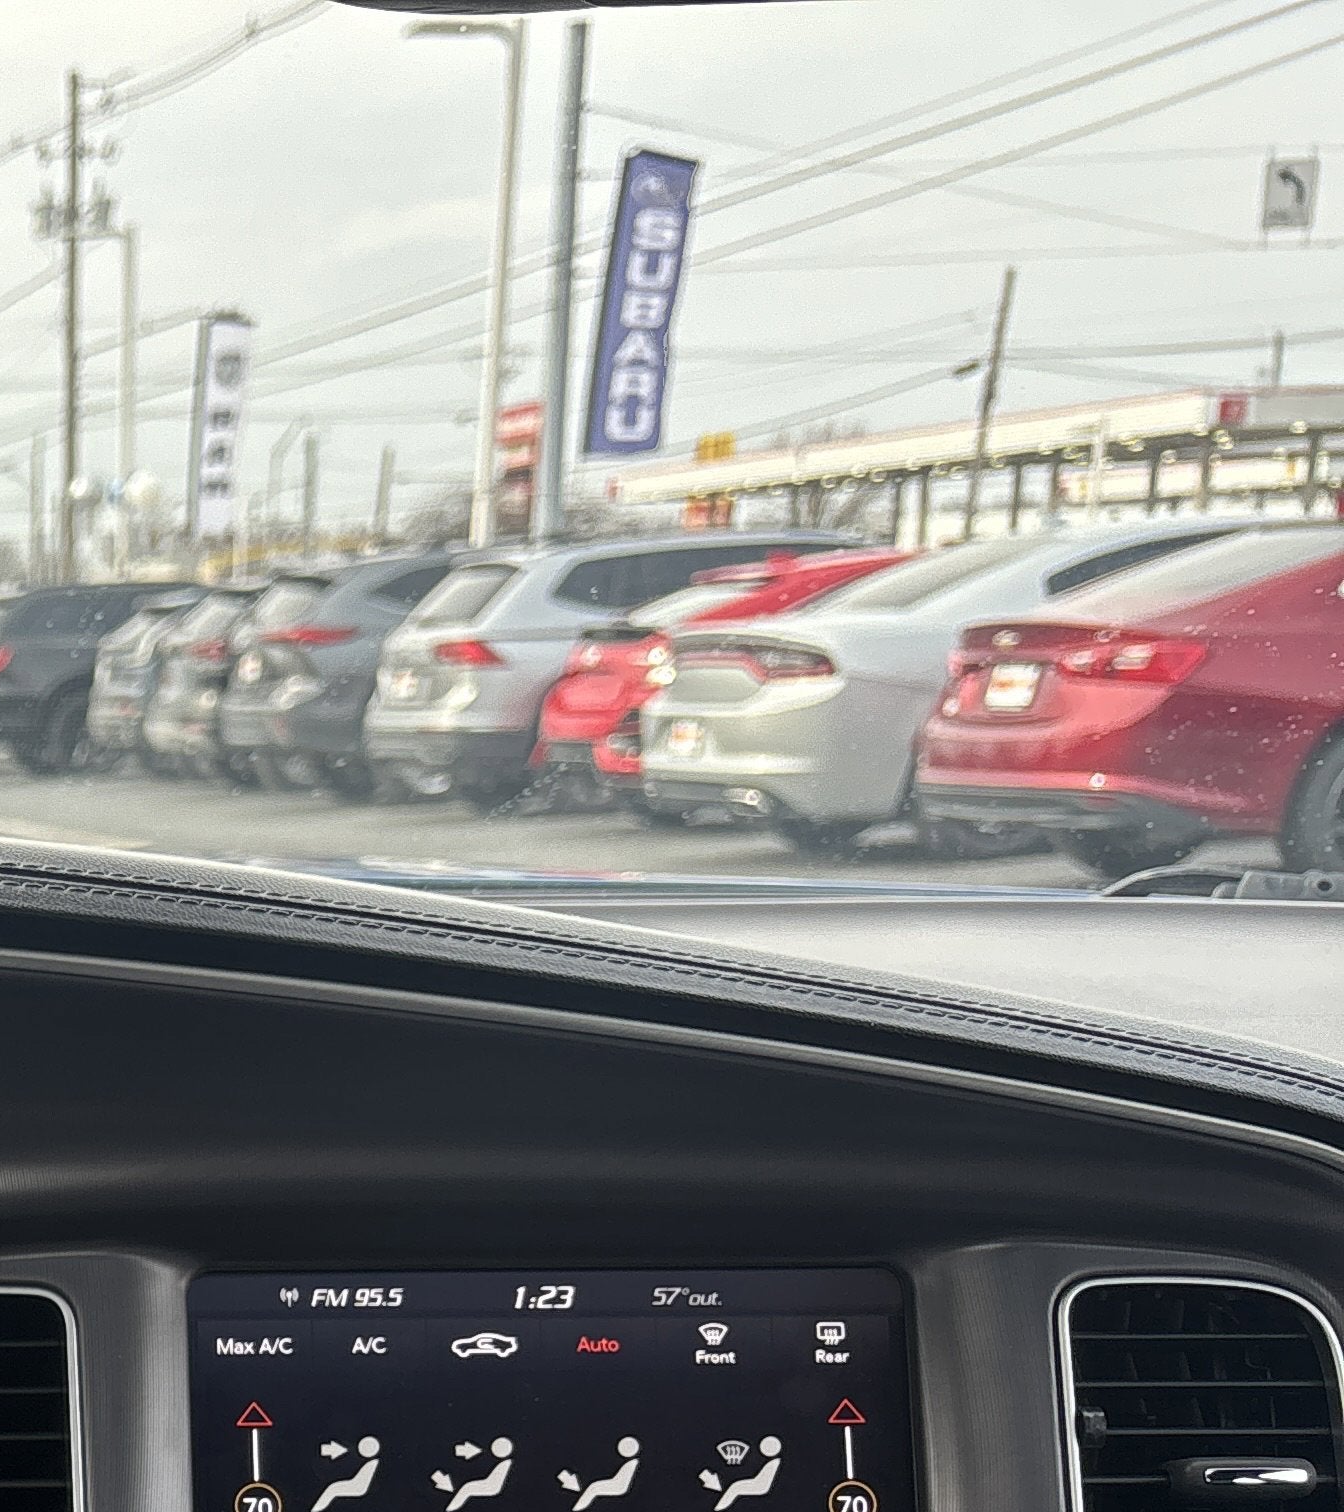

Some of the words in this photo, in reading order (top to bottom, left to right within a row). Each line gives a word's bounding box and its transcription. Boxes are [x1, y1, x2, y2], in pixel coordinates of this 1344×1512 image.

[604, 207, 682, 442] SUBARU
[311, 1288, 349, 1307] FM
[353, 1288, 404, 1307] 95.5
[513, 1285, 575, 1310] 1:23
[216, 1338, 256, 1356] Max
[259, 1337, 294, 1355] A/C
[352, 1336, 387, 1355] A/C
[577, 1337, 620, 1354] Auto
[695, 1350, 736, 1364] Front
[815, 1349, 850, 1364] Rear
